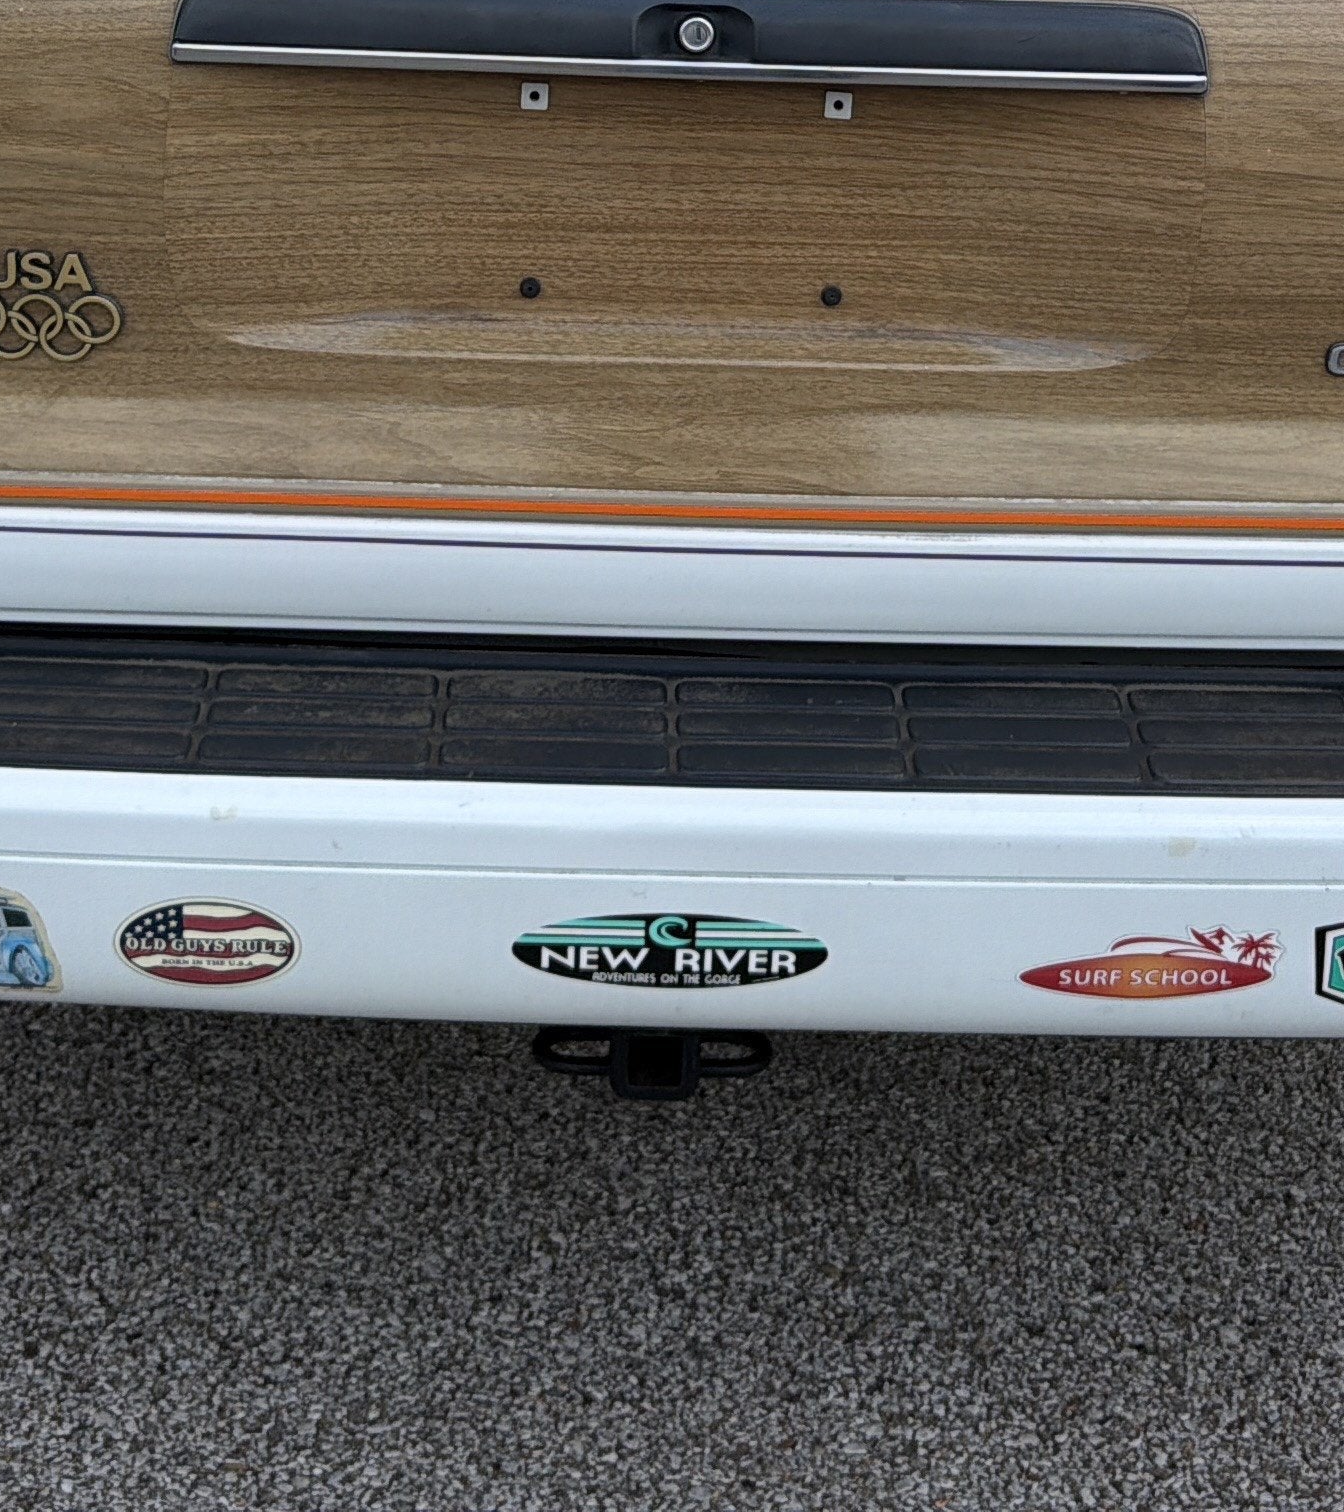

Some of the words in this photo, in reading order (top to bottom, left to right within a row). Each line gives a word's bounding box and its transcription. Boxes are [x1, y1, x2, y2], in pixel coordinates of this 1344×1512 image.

[126, 938, 167, 952] OLD
[171, 939, 226, 952] GUYS
[231, 939, 288, 954] RULE
[540, 946, 650, 971] NEW
[675, 948, 797, 975] RIVER
[592, 971, 657, 984] ADVENTURES
[660, 973, 679, 984] ON
[682, 973, 701, 985] THE
[705, 973, 742, 986] GORGE
[1058, 968, 1123, 986] SURF
[1128, 969, 1233, 986] SCHOOL
